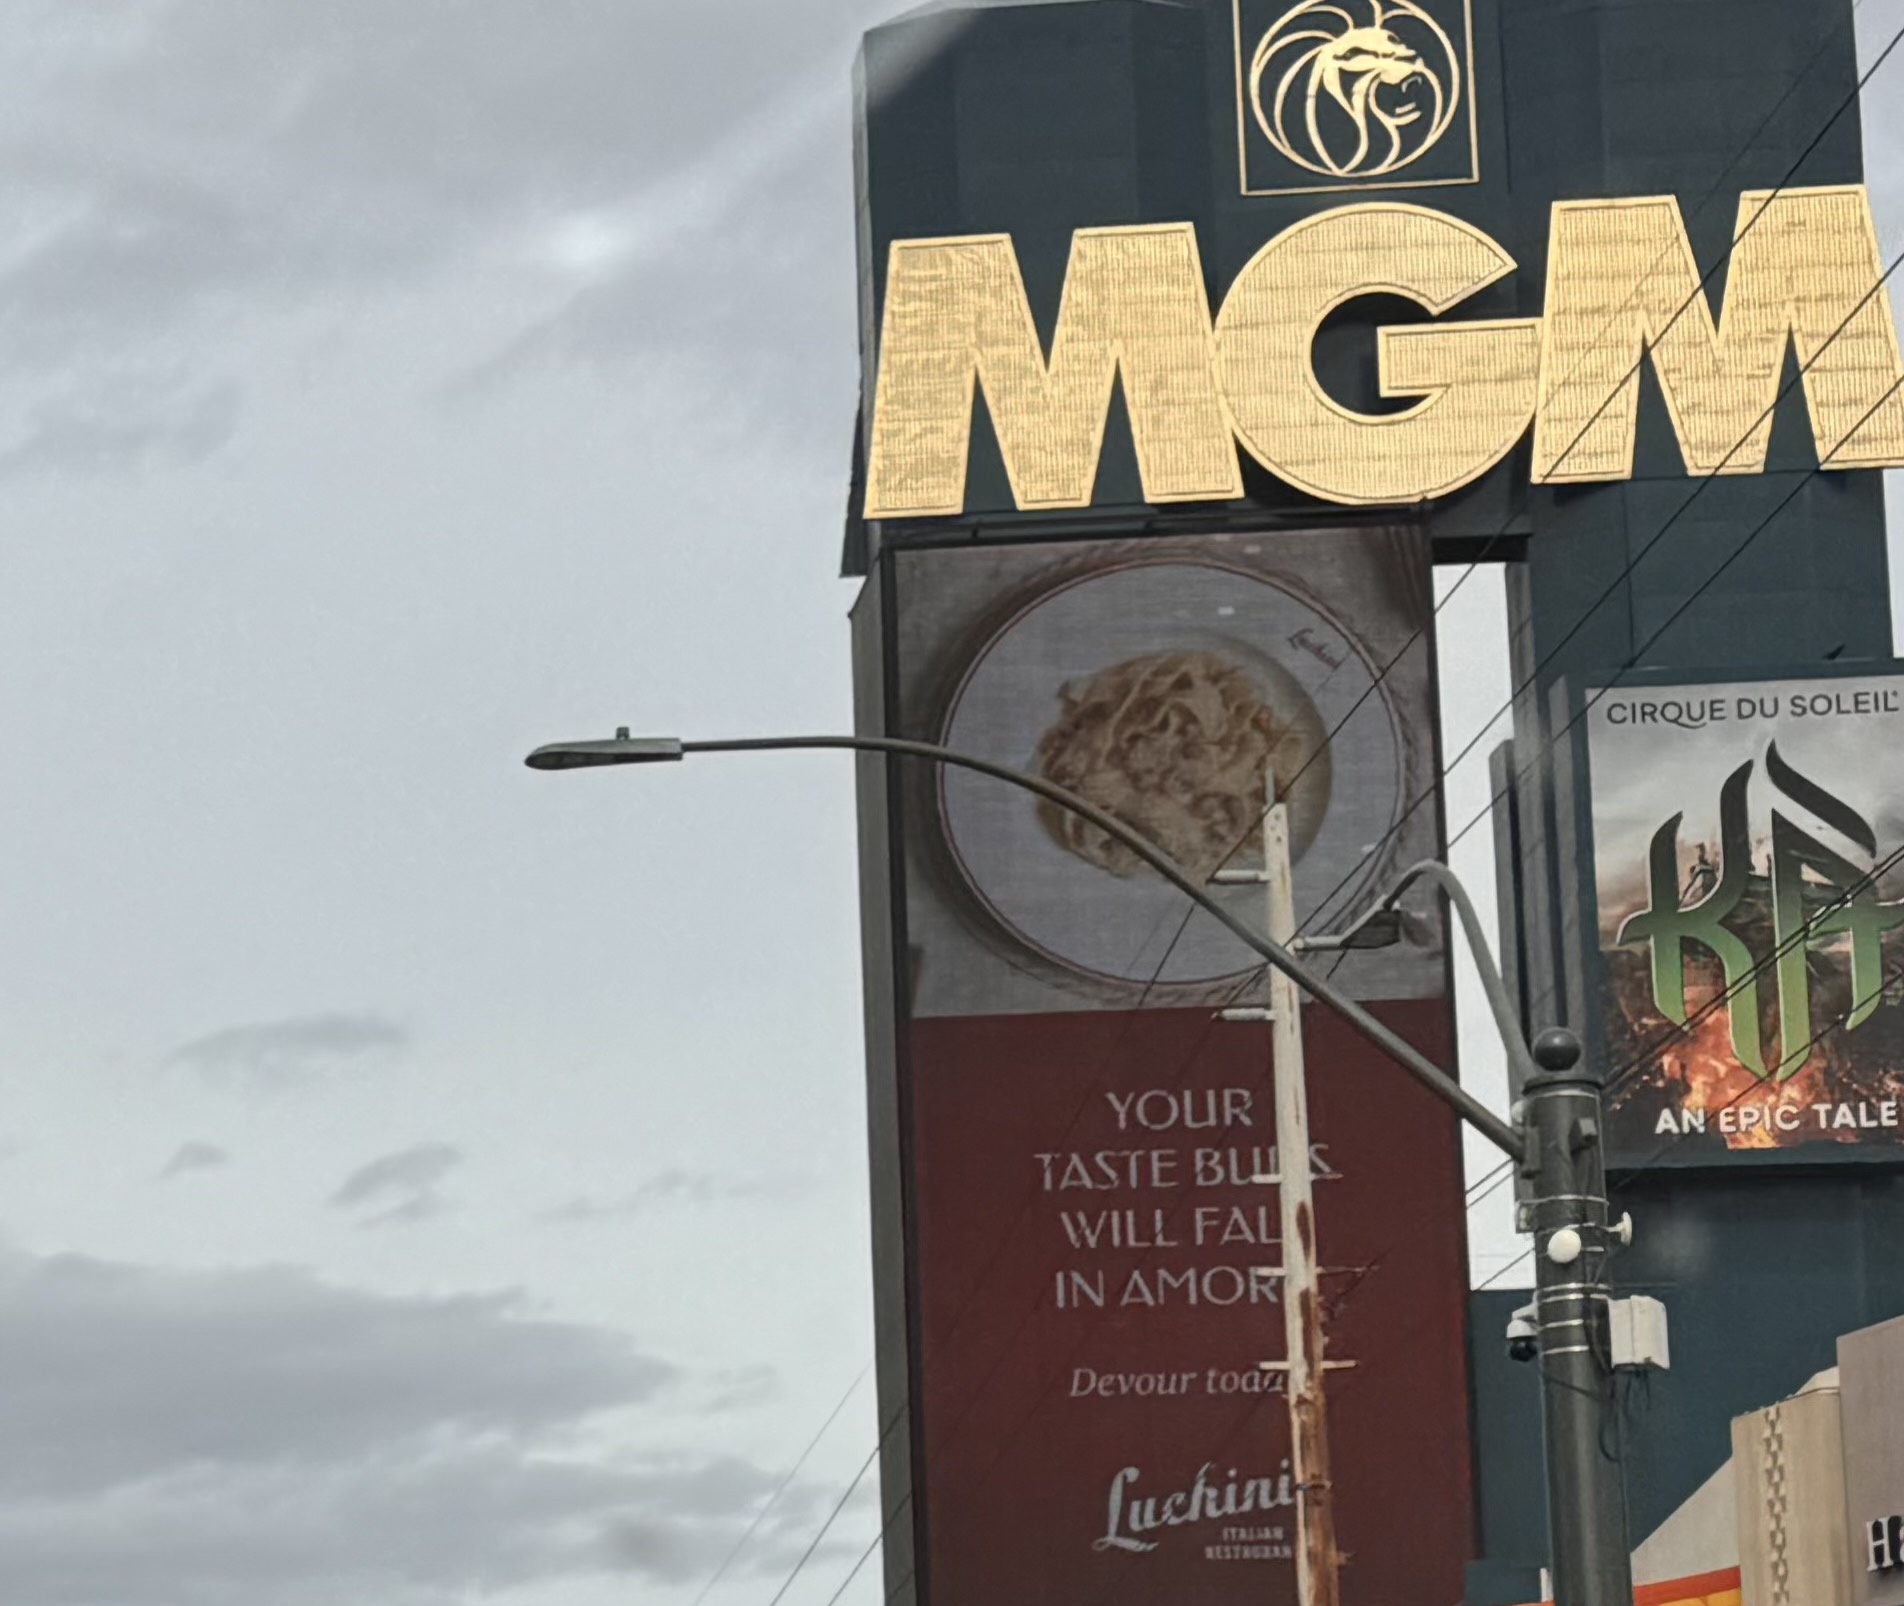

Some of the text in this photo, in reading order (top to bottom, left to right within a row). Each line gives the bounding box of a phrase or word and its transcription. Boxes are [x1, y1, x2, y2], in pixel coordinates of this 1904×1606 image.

[863, 186, 1904, 518] MGM
[1606, 700, 1728, 729] CIRQUE
[1736, 697, 1780, 720] DU
[1106, 1088, 1253, 1130] YOUR
[1654, 1101, 1899, 1134] AN EPIC TALE
[1034, 1143, 1332, 1191] TASTE BUS
[1060, 1206, 1283, 1249] WILL FAL
[1056, 1266, 1279, 1308] IN AMOR
[1069, 1367, 1288, 1398] Devour toda
